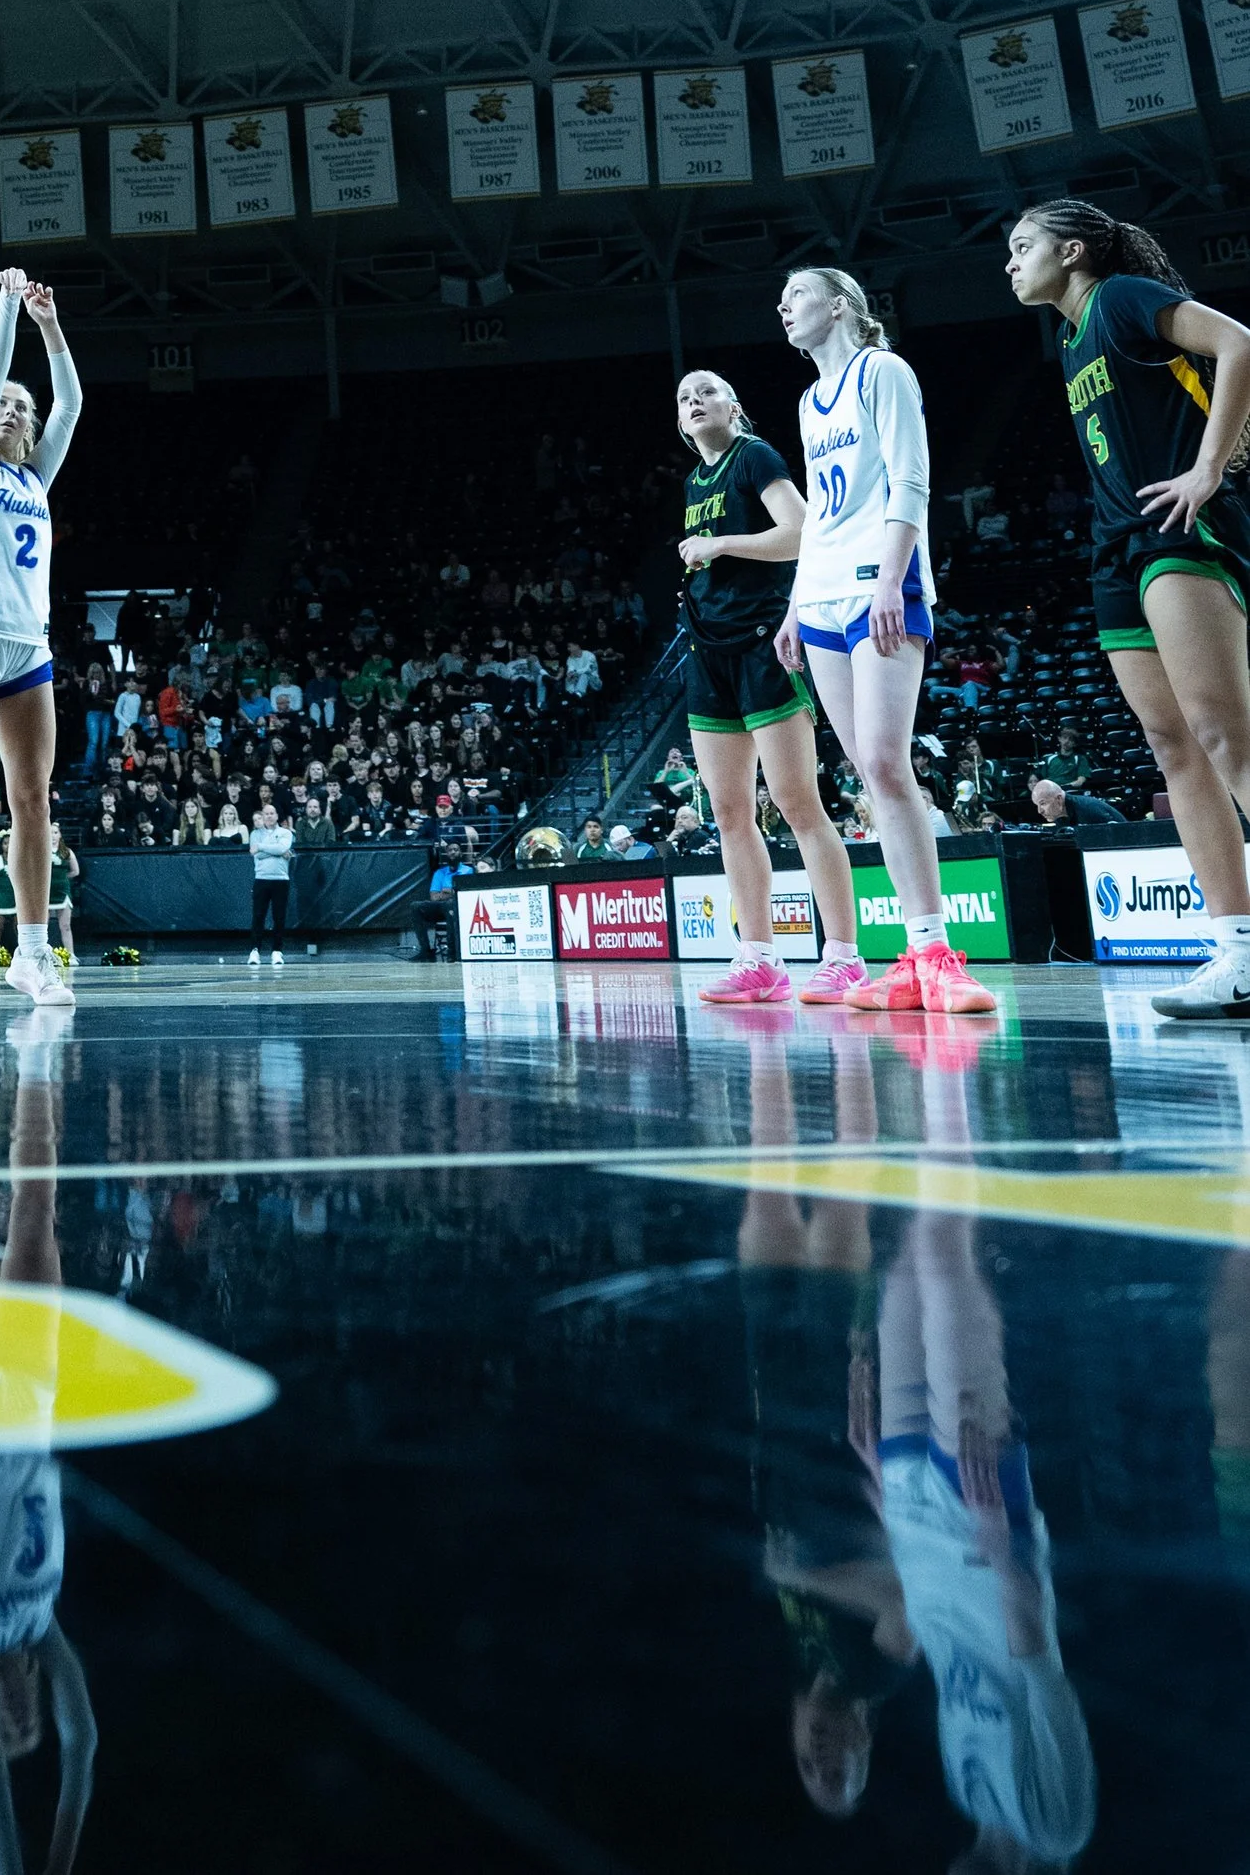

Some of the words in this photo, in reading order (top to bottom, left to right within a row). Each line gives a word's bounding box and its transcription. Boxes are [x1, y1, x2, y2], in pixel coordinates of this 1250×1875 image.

[1125, 92, 1165, 113] 2016
[1006, 116, 1042, 137] 2015
[810, 146, 846, 164] 2014
[584, 165, 622, 182] 2006
[686, 159, 723, 175] 2012
[479, 172, 513, 188] 1987
[337, 185, 372, 201] 1985
[236, 197, 270, 214] 1983
[27, 218, 61, 232] 1976
[138, 210, 170, 225] 1981
[1086, 413, 1109, 466] 5
[685, 490, 727, 530] OUTH
[15, 523, 38, 568] 2
[1125, 873, 1205, 919] JumpS
[681, 901, 703, 917] 103.7
[772, 902, 809, 922] KFH
[858, 896, 904, 926] DELT
[942, 892, 996, 925] NTAL
[682, 918, 715, 939] KEYN
[470, 936, 506, 954] ROOFING
[594, 932, 626, 949] CREDIT
[627, 931, 657, 948] UNION
[1112, 947, 1129, 957] FIND
[1130, 946, 1169, 957] LOCATIONS
[1170, 946, 1179, 957] AT
[1179, 946, 1211, 957] JUMPSTA
